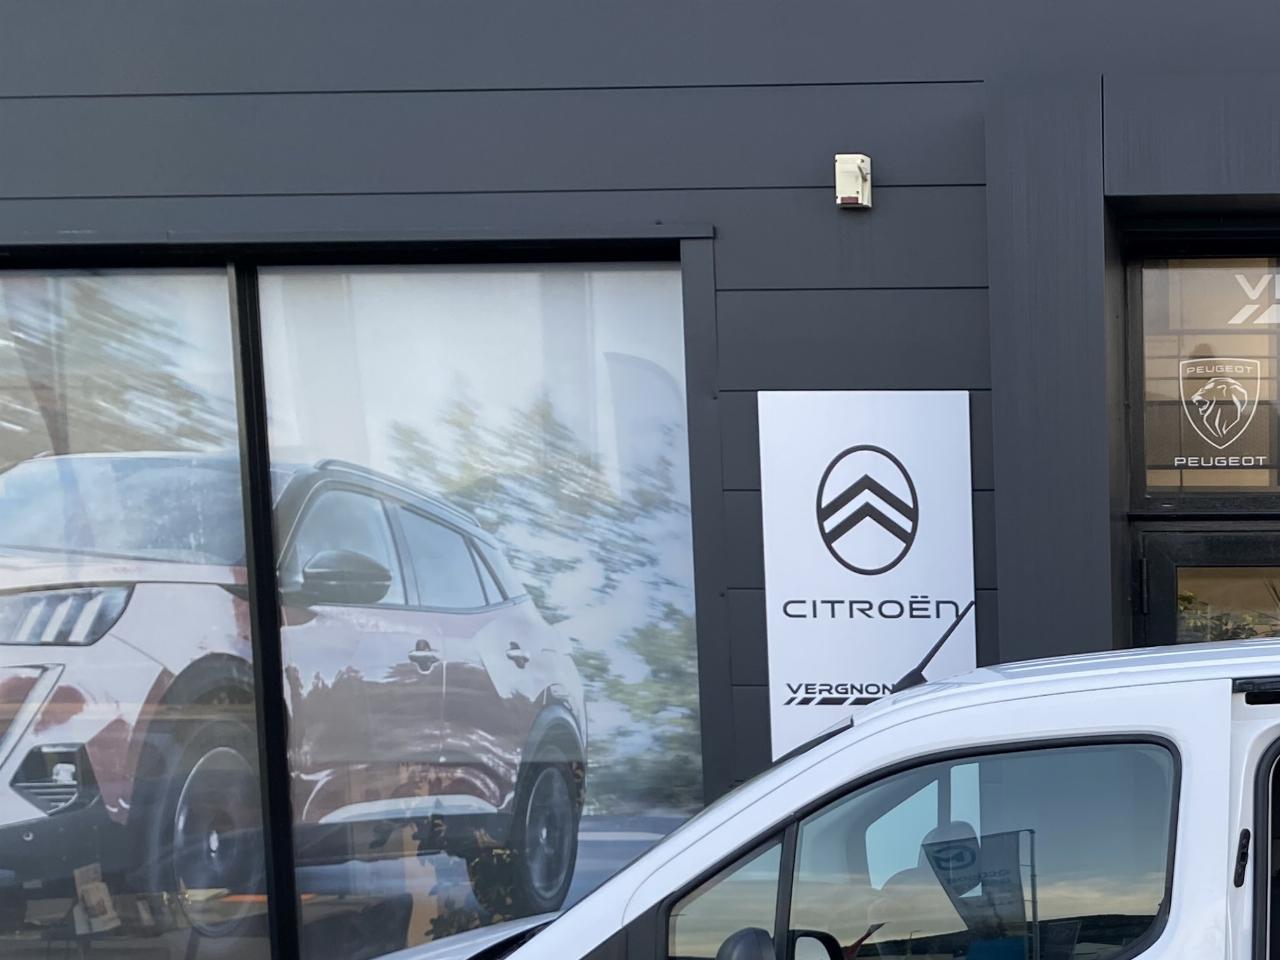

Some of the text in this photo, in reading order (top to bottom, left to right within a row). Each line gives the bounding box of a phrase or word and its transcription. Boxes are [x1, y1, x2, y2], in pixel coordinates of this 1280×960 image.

[1186, 364, 1253, 375] PEUGEOT
[1173, 456, 1268, 467] PEUGEOT
[786, 683, 896, 695] VERGNON
